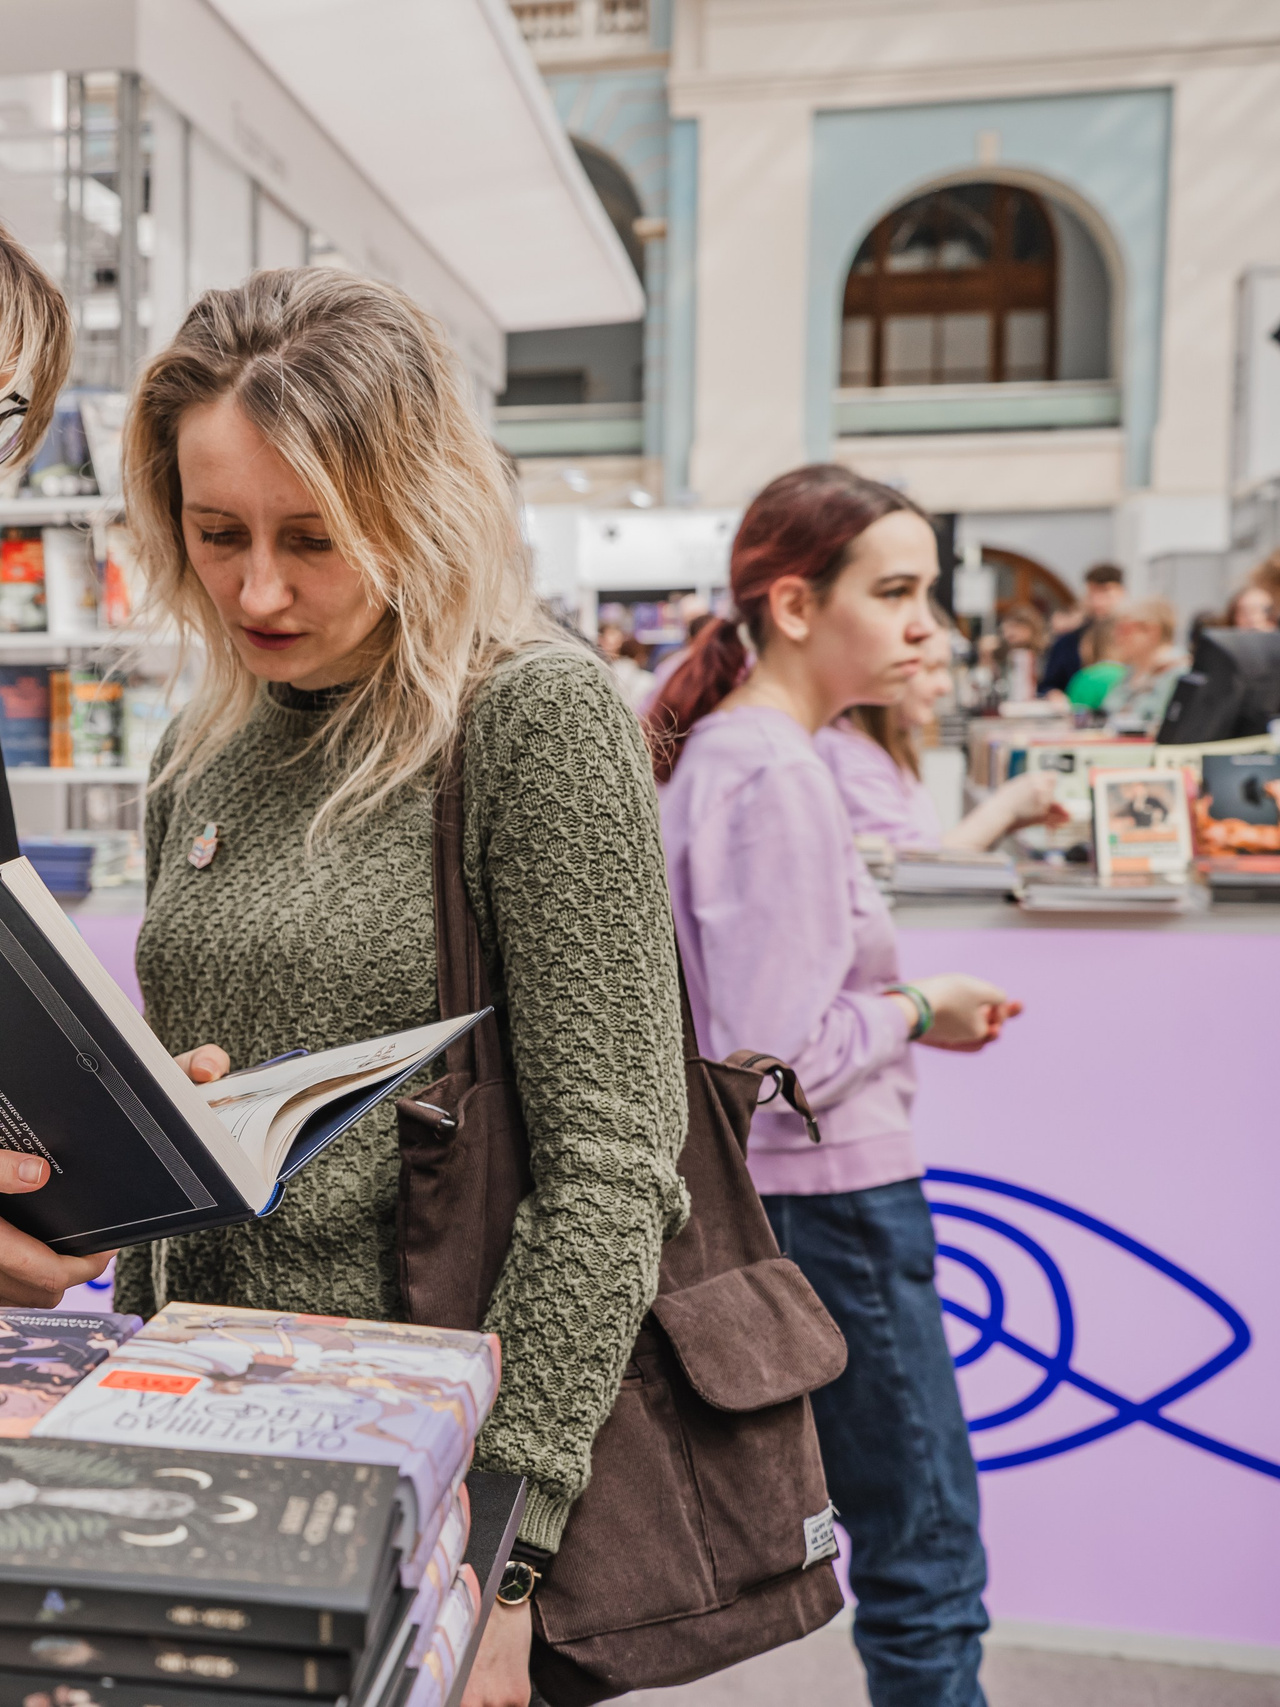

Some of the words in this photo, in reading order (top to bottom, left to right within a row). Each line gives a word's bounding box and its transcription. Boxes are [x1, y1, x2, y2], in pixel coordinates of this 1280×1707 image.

[18, 1121, 63, 1173] руководство
[22, 1138, 34, 1149] От
[137, 1392, 355, 1431] ДЕВОЧКА
[113, 1411, 348, 1454] ОДАРЕННАЯ
